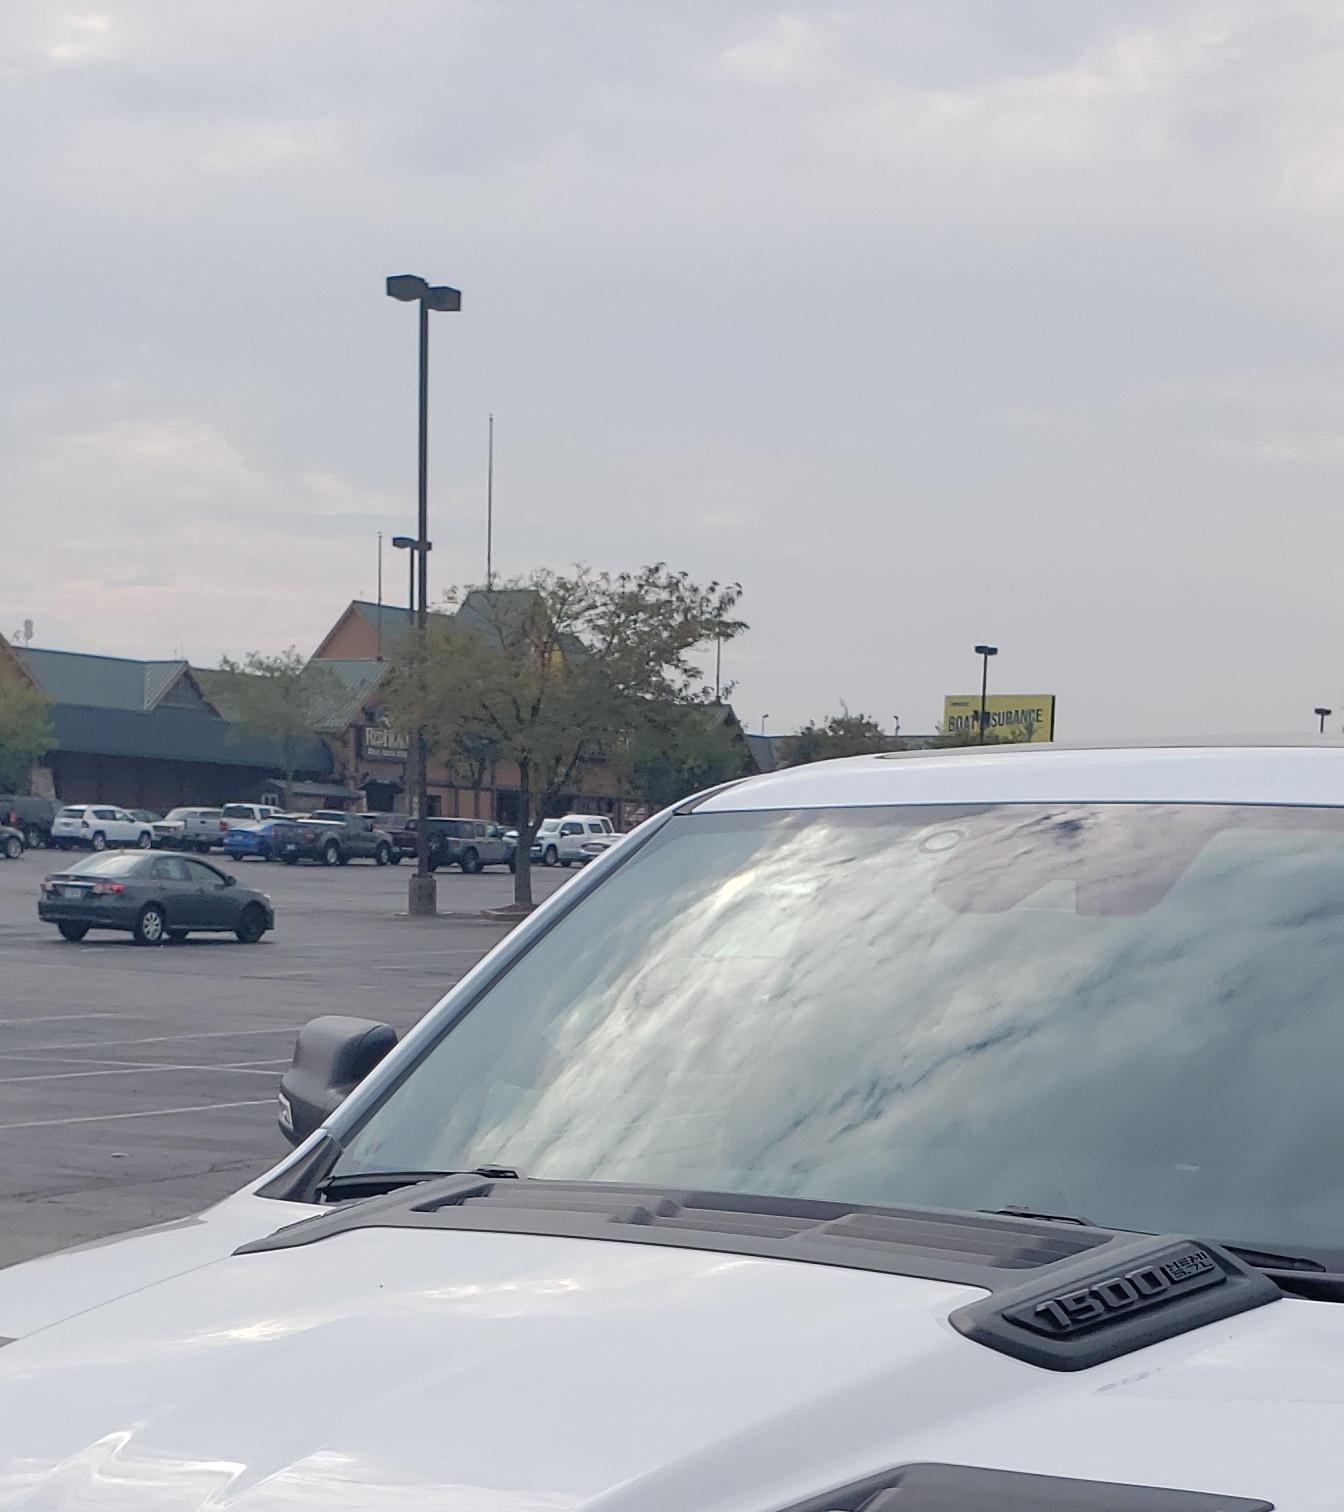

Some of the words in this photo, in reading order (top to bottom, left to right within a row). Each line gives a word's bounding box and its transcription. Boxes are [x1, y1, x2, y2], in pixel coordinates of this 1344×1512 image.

[981, 708, 1044, 731] SURANCE
[1165, 1251, 1208, 1272] HEMI
[1171, 1262, 1214, 1279] 5.7L
[1035, 1265, 1171, 1328] 1500
